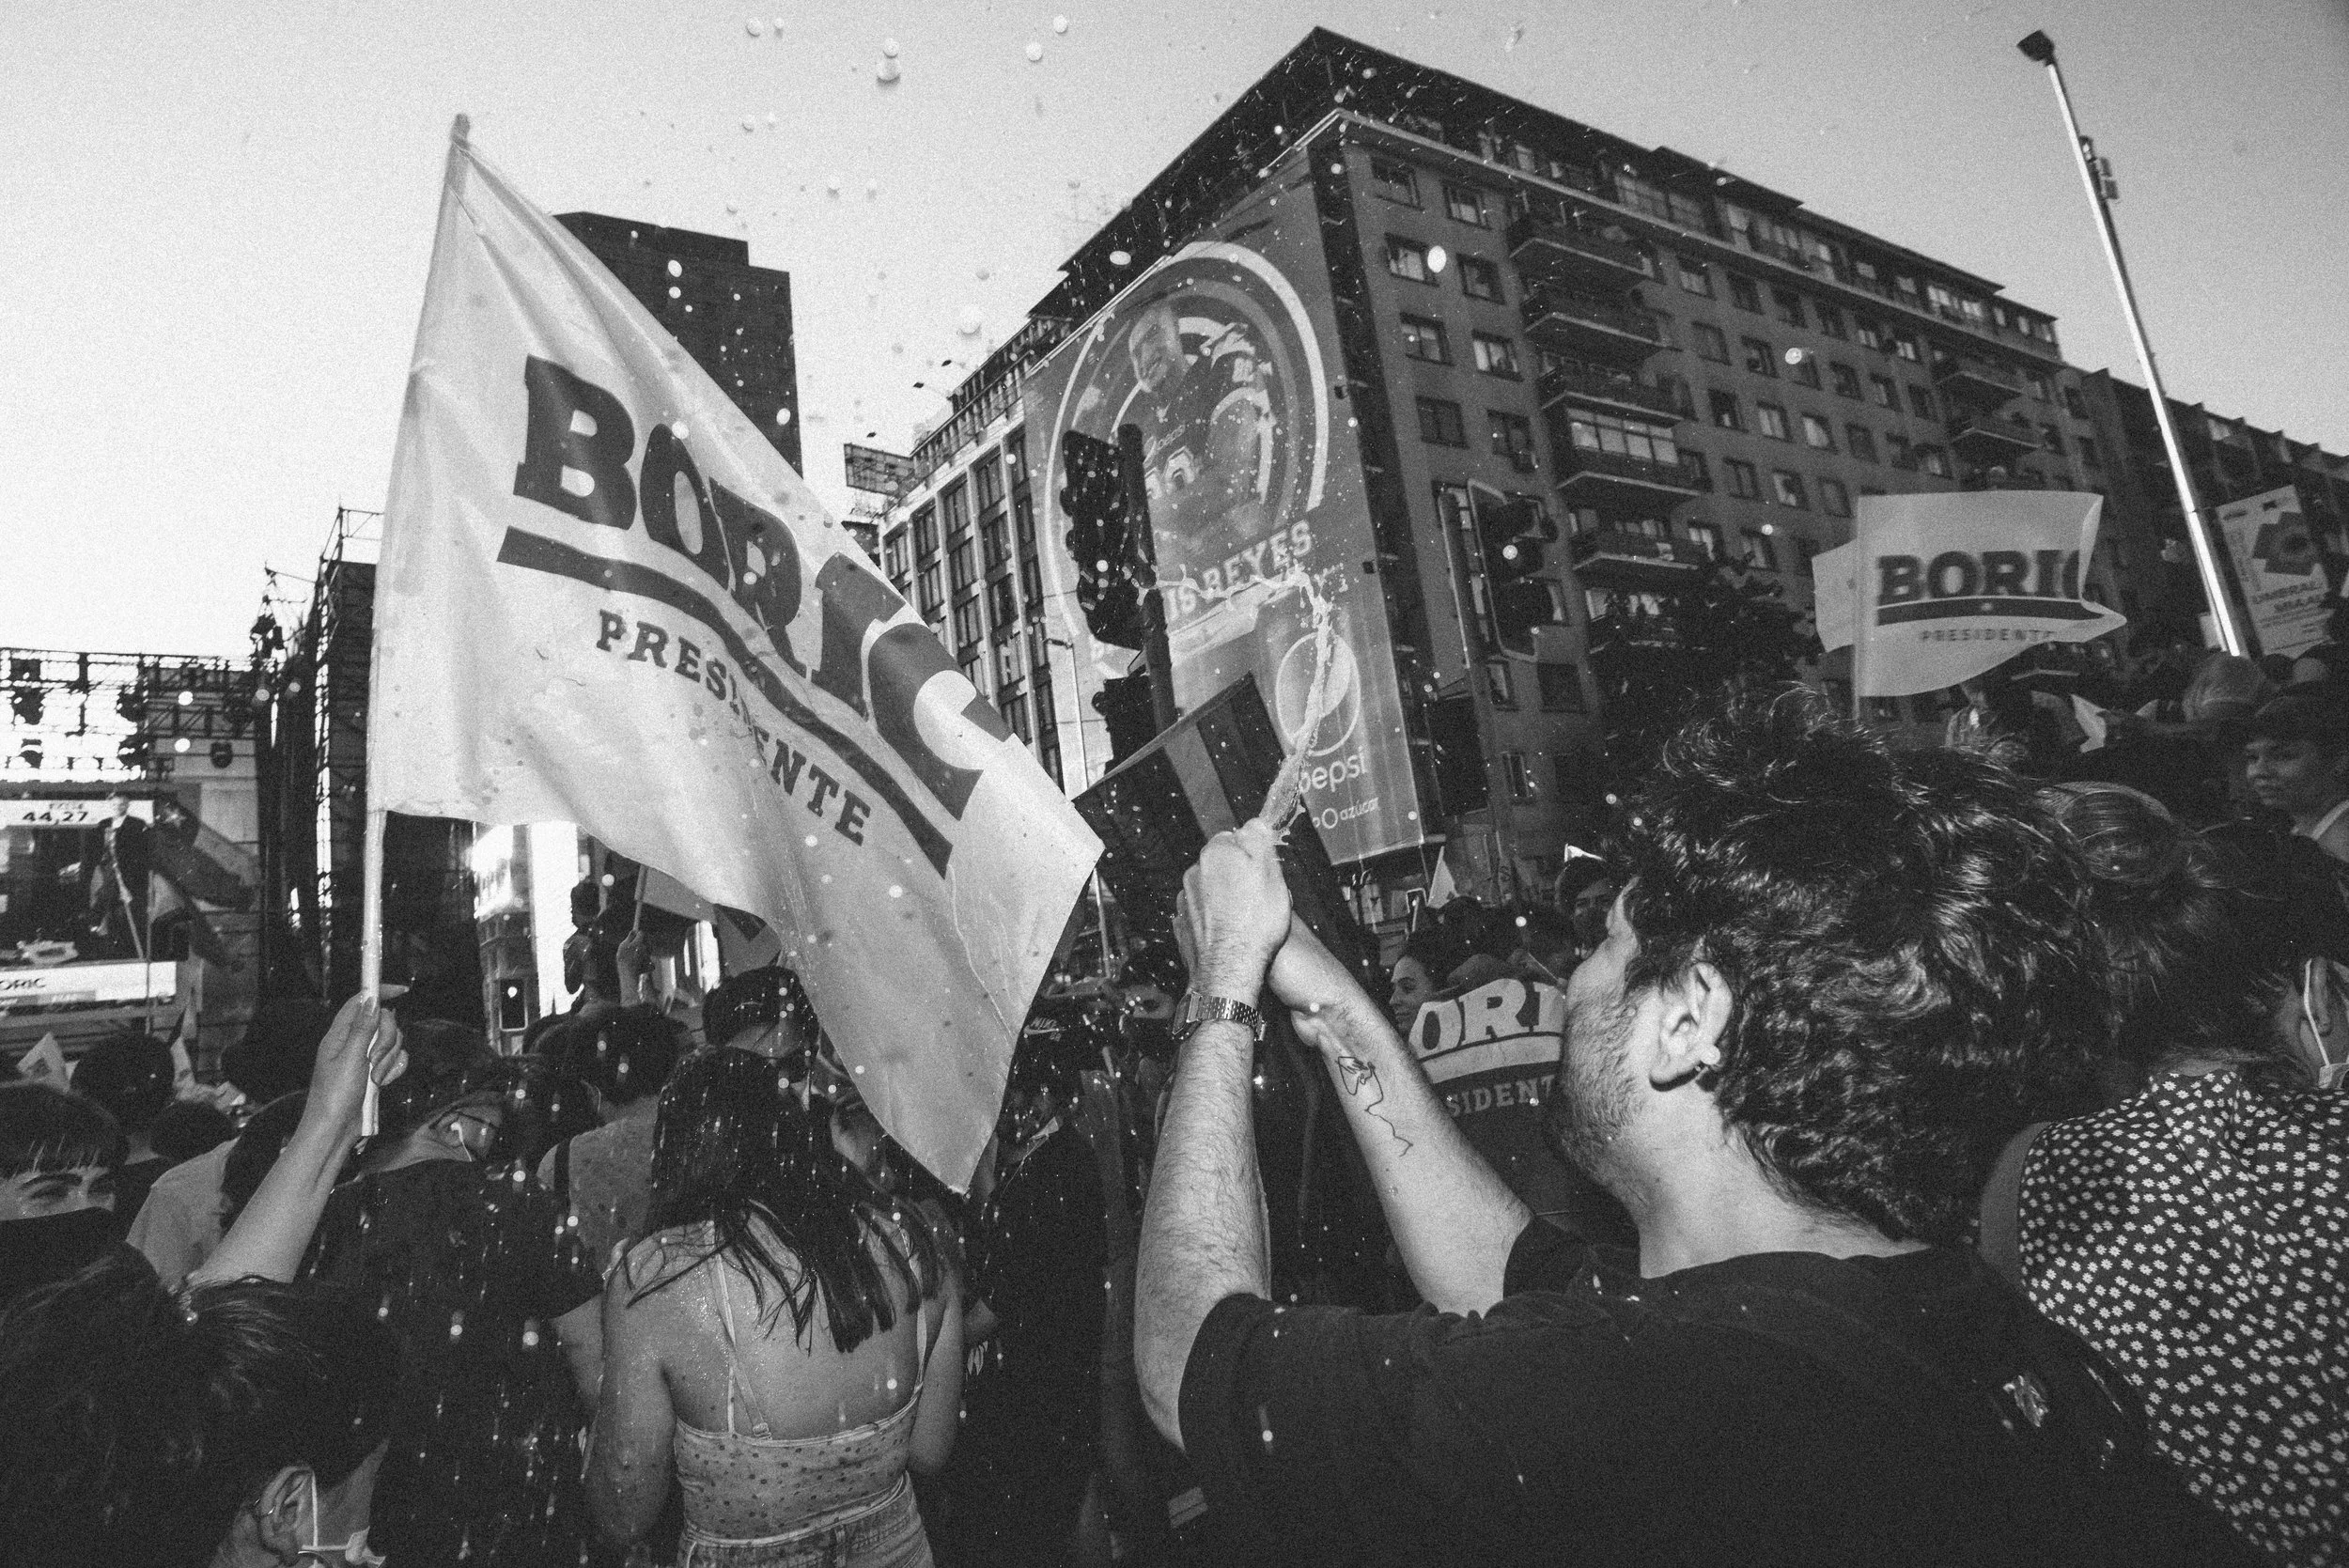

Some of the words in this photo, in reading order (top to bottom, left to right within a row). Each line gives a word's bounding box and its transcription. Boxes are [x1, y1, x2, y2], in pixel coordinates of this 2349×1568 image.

[513, 353, 1014, 821] BORIC
[596, 609, 872, 846] PRESIENTE
[0, 977, 47, 990] ORIC
[1408, 978, 1566, 1060] ORI
[1446, 1075, 1555, 1118] SIDENT
